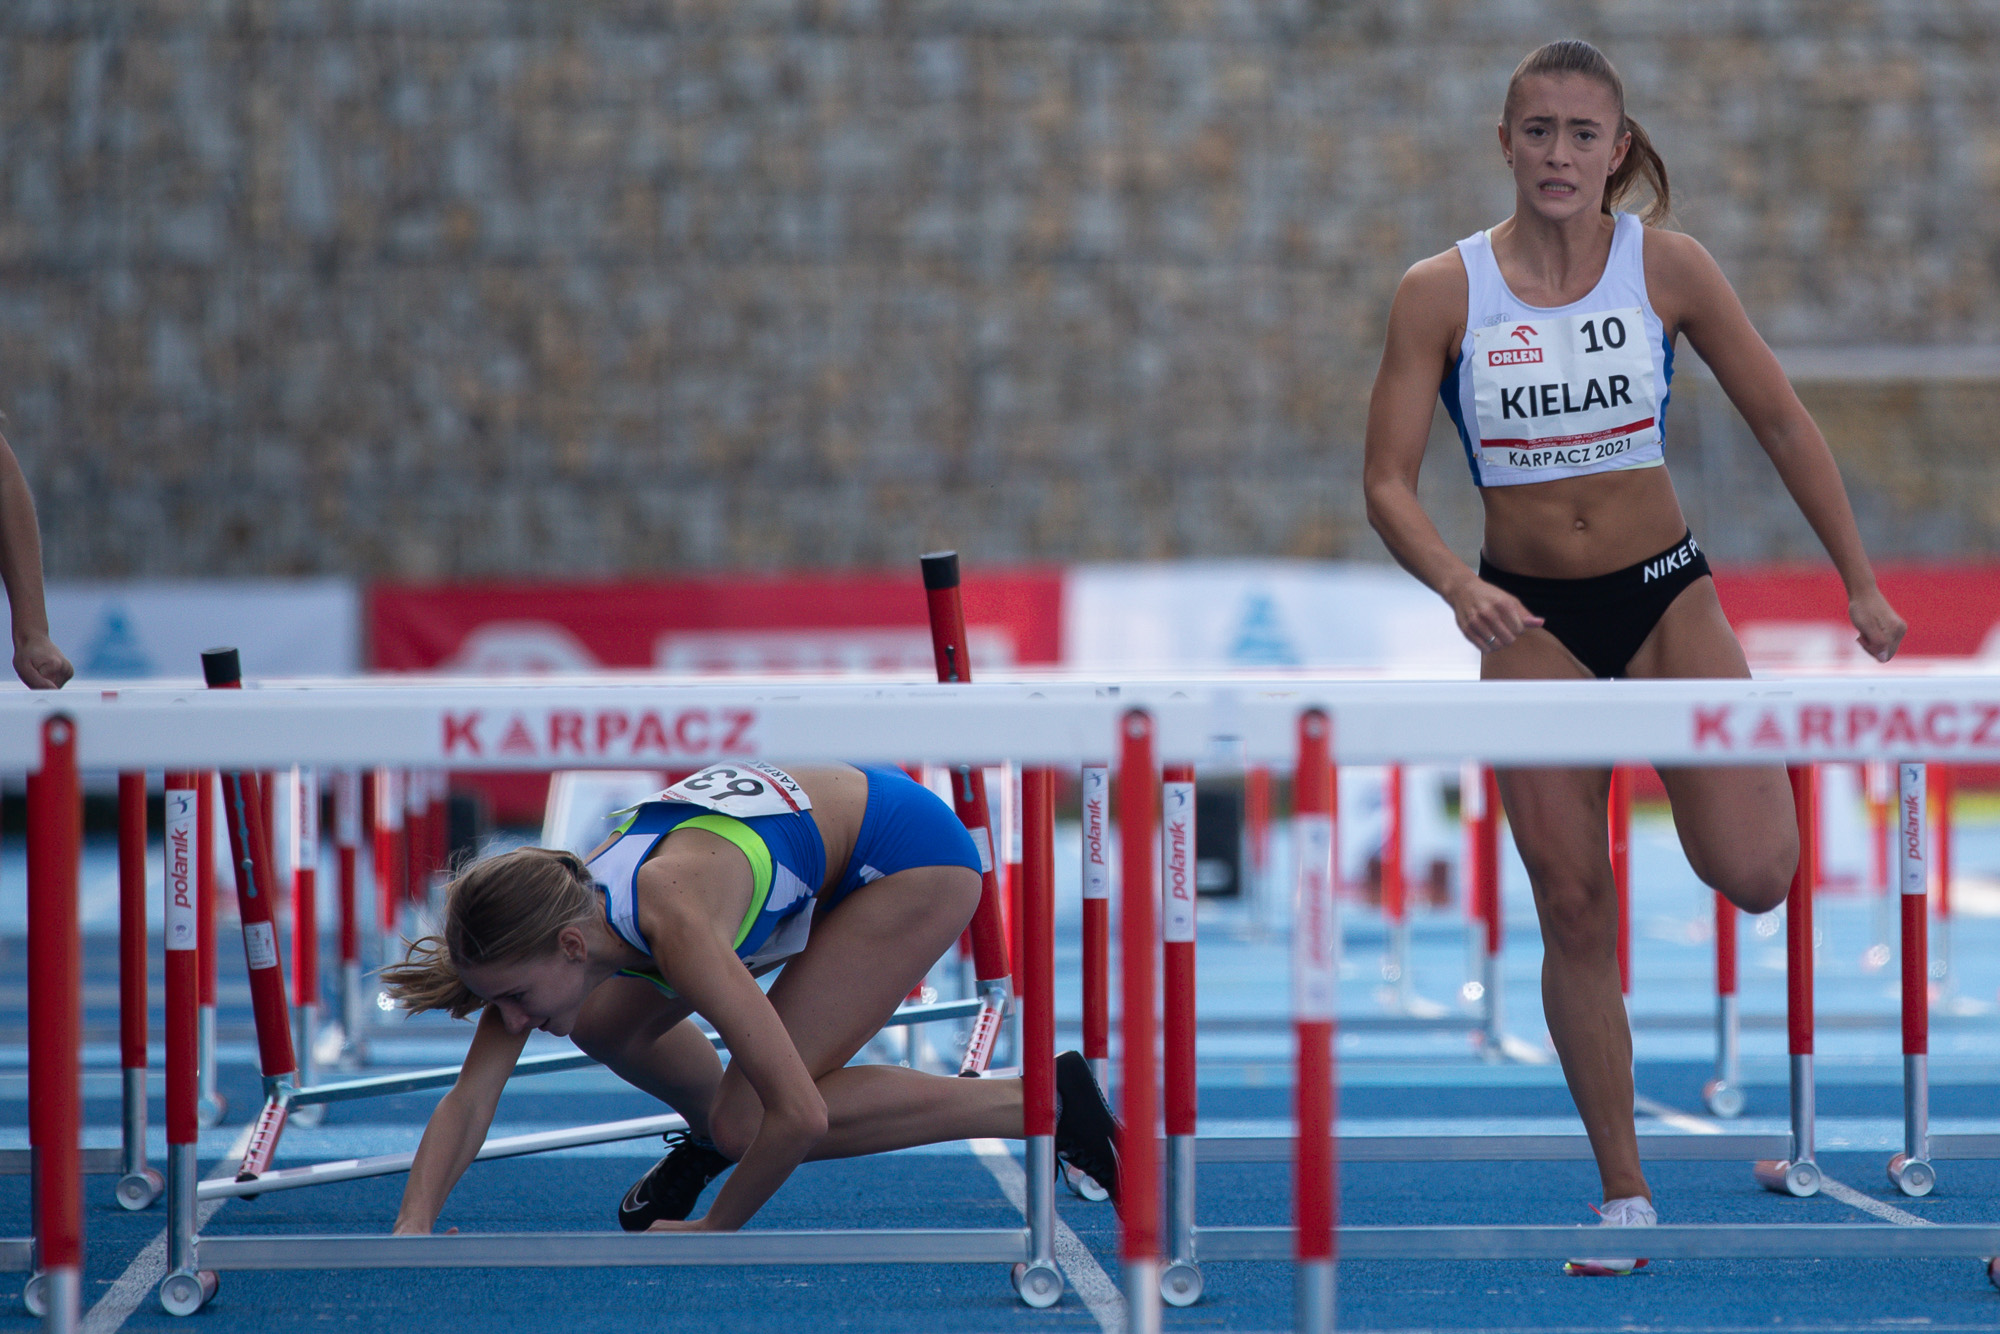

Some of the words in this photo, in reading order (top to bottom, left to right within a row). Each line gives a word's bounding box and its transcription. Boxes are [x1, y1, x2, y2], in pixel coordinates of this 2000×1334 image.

[1490, 349, 1541, 365] ORLEN
[1579, 316, 1627, 354] 10
[1500, 374, 1633, 420] KIELAR
[1508, 447, 1591, 467] KARPACZ
[1595, 437, 1631, 460] 2021
[1643, 545, 1692, 584] NIKE
[442, 708, 757, 755] KARPACZ
[1691, 702, 2000, 748] KARPACZ
[683, 769, 765, 801] 63
[1087, 798, 1105, 865] polanik
[1904, 795, 1923, 861] polanik
[170, 827, 192, 910] polanik
[1165, 820, 1189, 902] polanik
